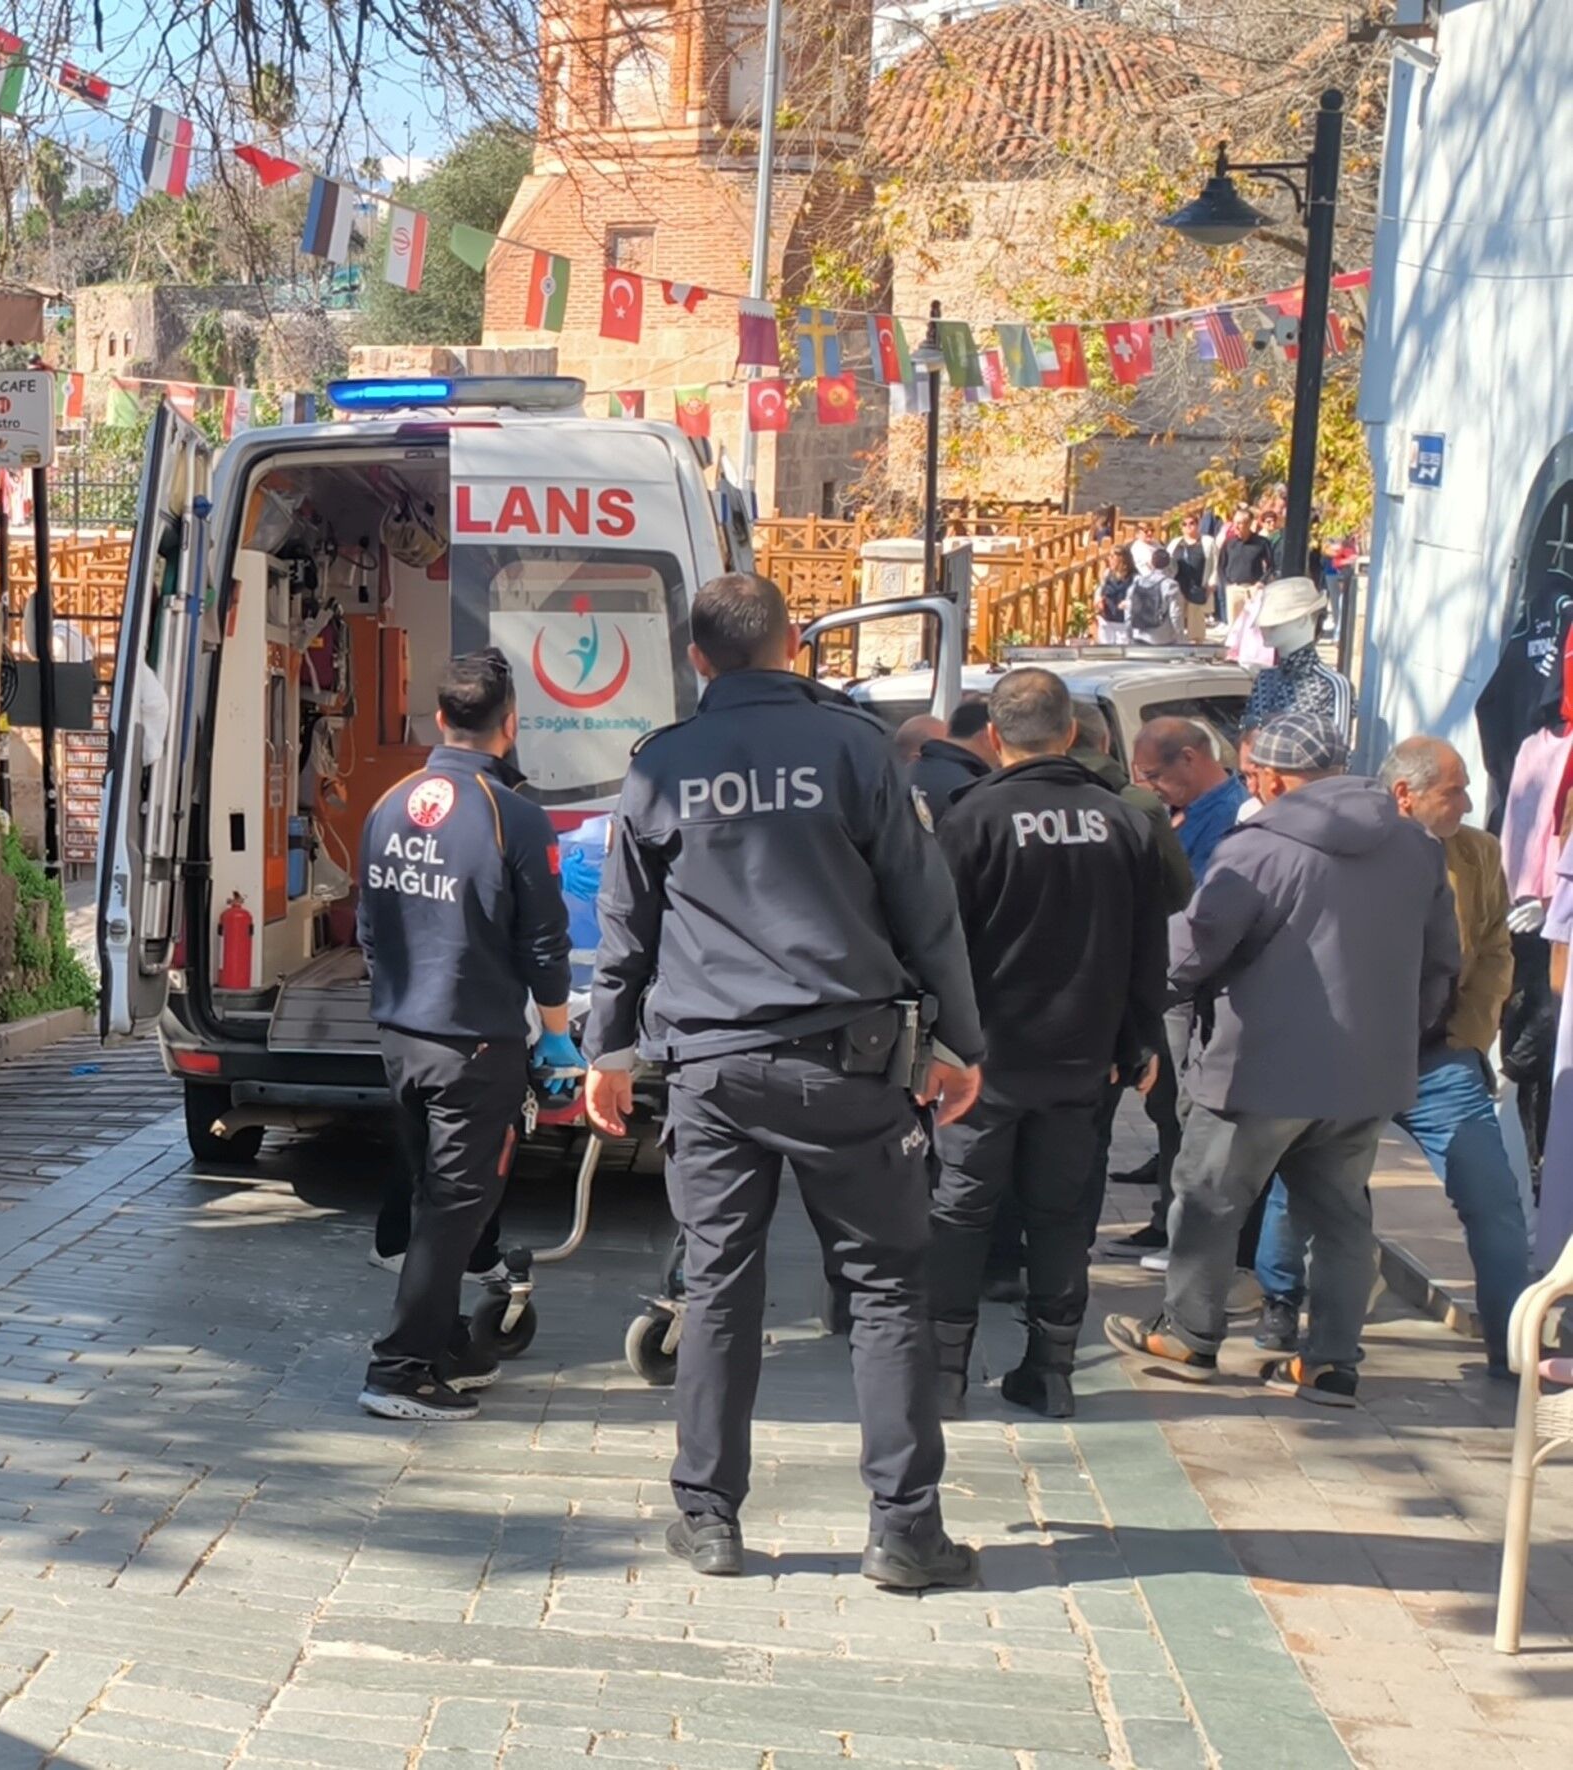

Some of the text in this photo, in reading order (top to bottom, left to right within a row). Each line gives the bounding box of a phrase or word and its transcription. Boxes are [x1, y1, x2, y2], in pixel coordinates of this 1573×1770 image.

[0, 379, 36, 393] CAFE
[455, 485, 636, 537] LANS
[384, 832, 445, 865] ACİL
[367, 863, 459, 902] SAĞLIK
